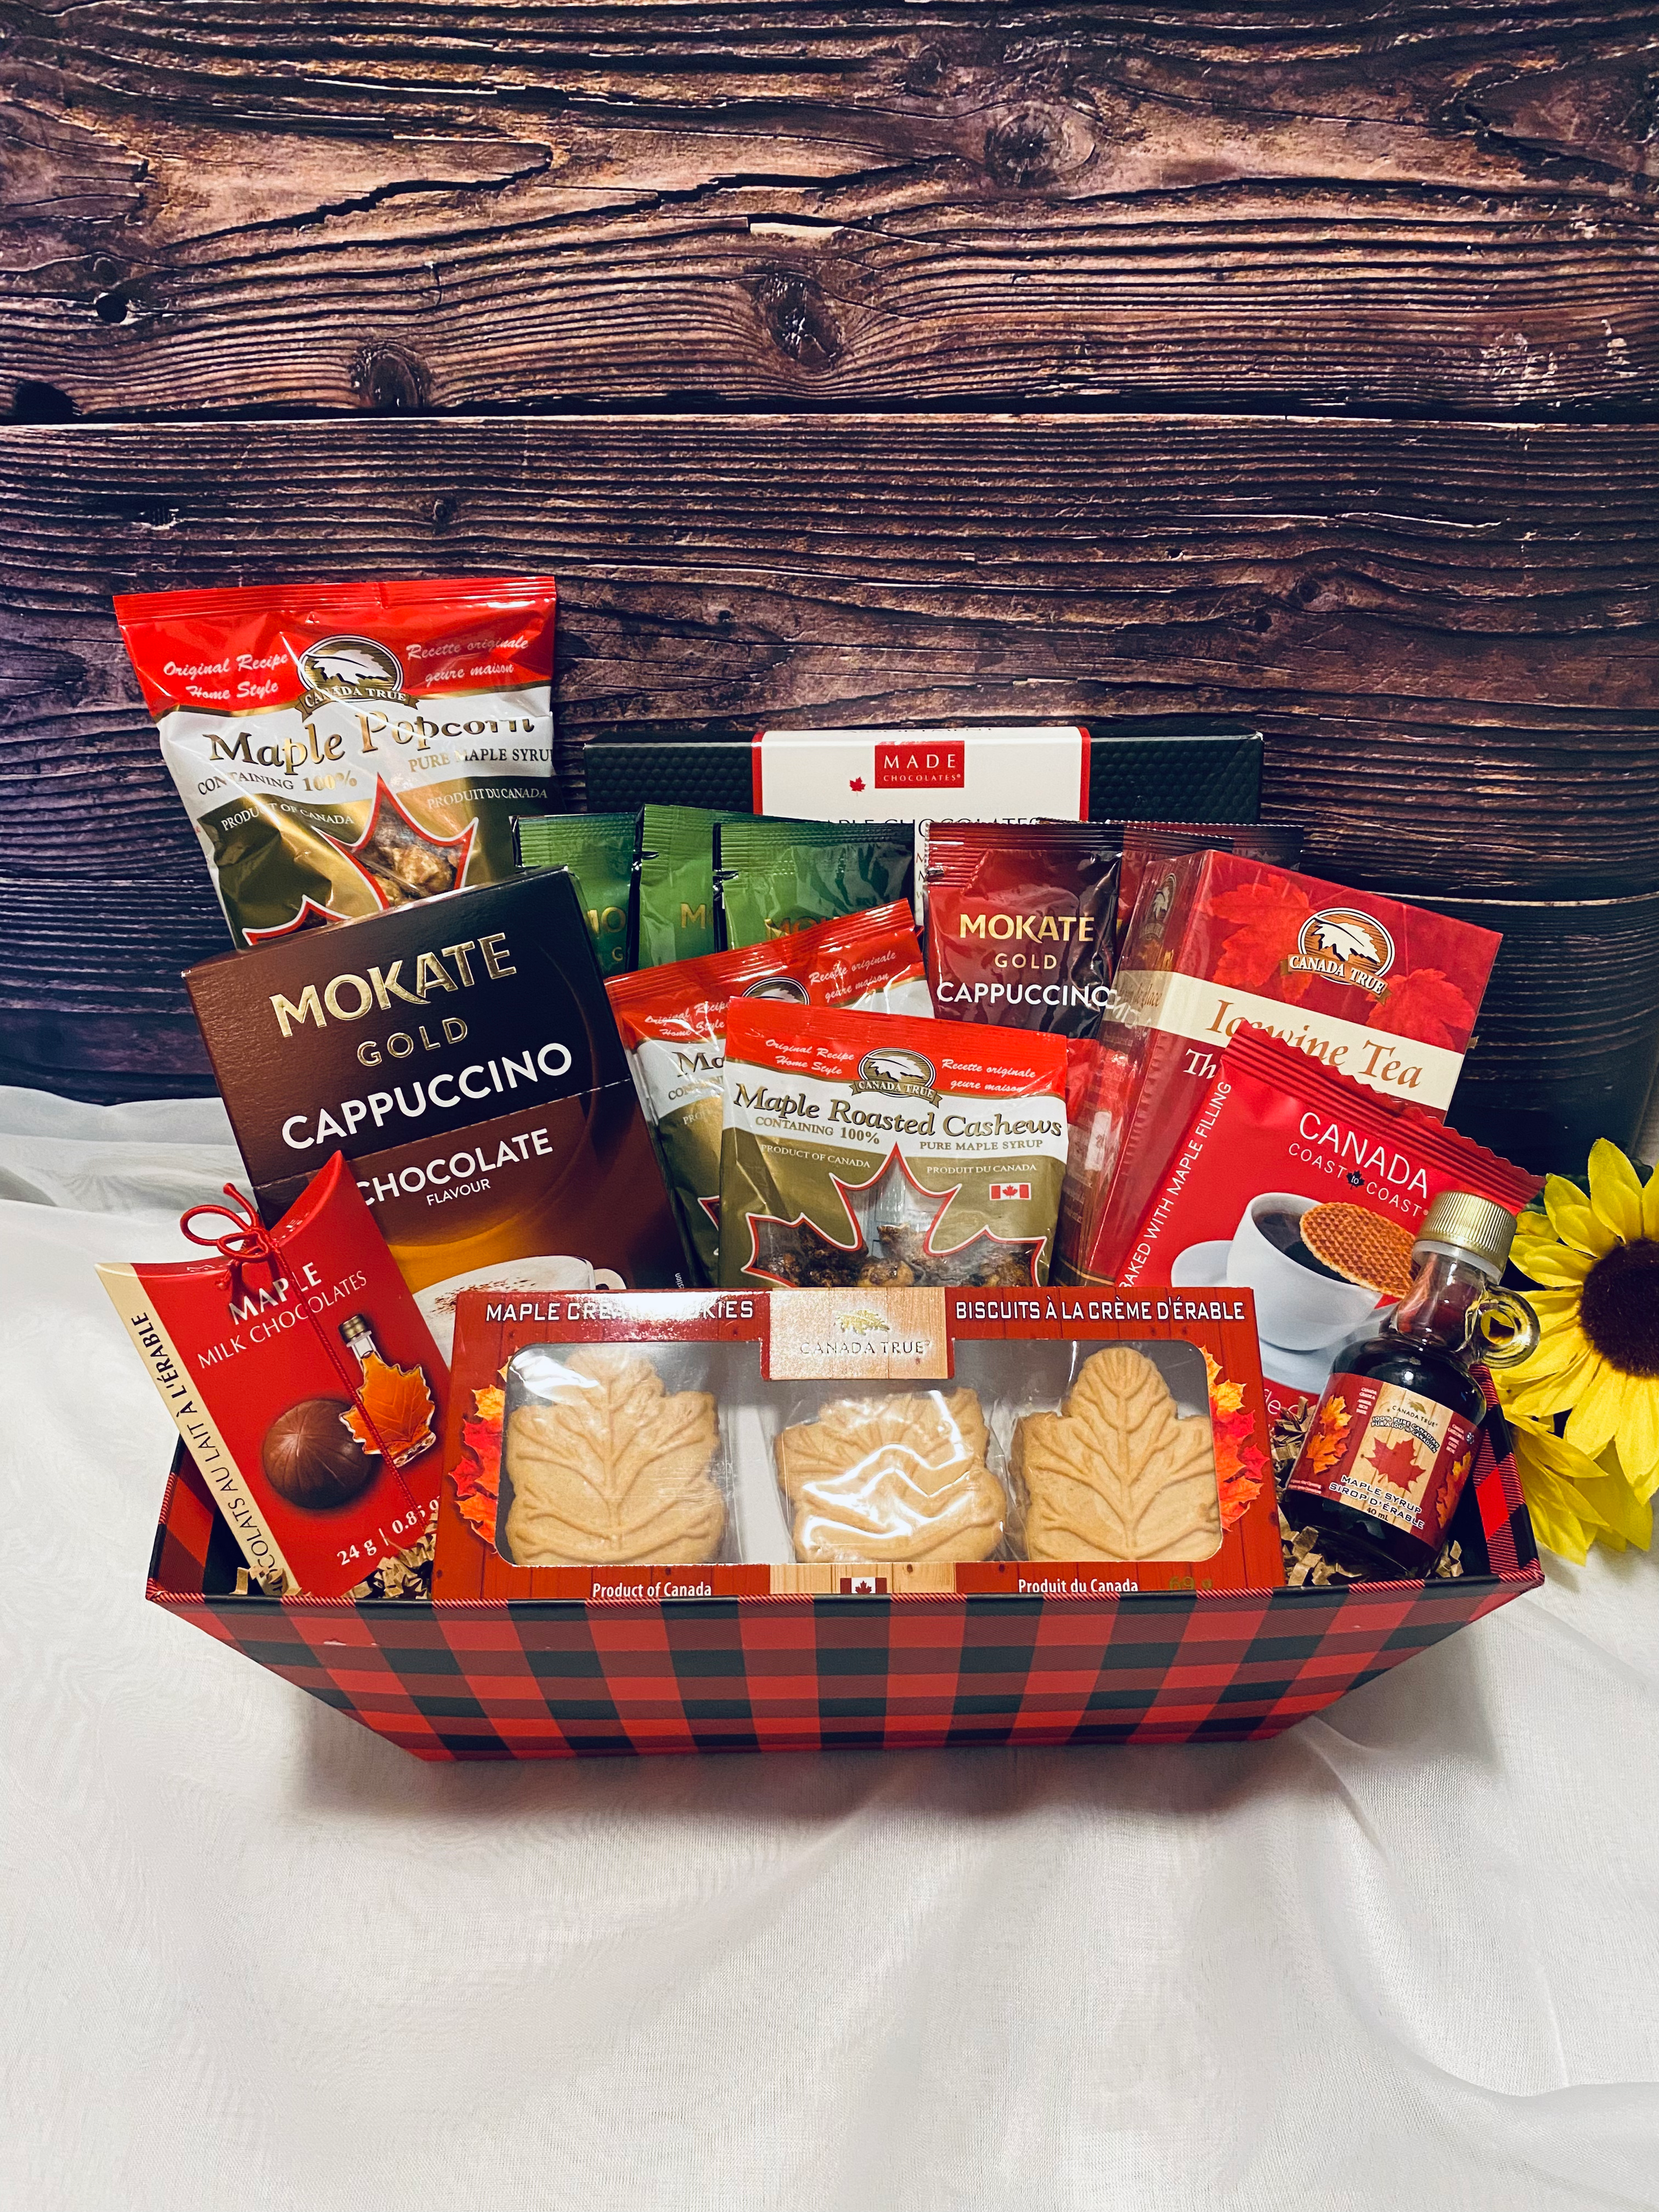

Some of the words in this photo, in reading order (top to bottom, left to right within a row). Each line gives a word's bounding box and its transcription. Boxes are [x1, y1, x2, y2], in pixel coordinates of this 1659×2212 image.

[405, 644, 461, 661] Recette
[467, 635, 529, 654] originale
[163, 658, 230, 680] Original
[236, 653, 288, 672] Recipe
[470, 663, 515, 675] maison
[185, 686, 230, 700] Home
[236, 679, 279, 698] Style
[304, 686, 363, 708] CANADA
[365, 688, 407, 701] TRUE
[202, 723, 346, 775] Maple
[354, 711, 535, 753] Popcorn
[408, 752, 450, 772] PURE
[454, 748, 507, 761] MAPLE
[512, 748, 553, 761] SYRU
[884, 754, 956, 769] MADE
[198, 772, 294, 795] CONTAINING
[304, 770, 357, 791] 100%
[427, 788, 485, 809] PRODUIT
[486, 788, 500, 798] DU
[501, 788, 548, 799] CANADA
[221, 803, 277, 831] PRODUT
[280, 803, 297, 812] OF
[300, 809, 355, 825] CANADA
[960, 913, 1094, 944] MOKATE
[851, 950, 896, 971] originale
[995, 953, 1057, 969] GOLD
[269, 932, 517, 1037] MOKATE
[855, 973, 889, 989] maison
[1289, 955, 1346, 978] CANADA
[1349, 967, 1385, 995] TRUE
[936, 981, 1110, 1007] CAPPUCCINO
[357, 1017, 468, 1066] GOLD
[659, 1028, 691, 1036] Home
[765, 1039, 812, 1054] Original
[816, 1047, 855, 1062] Recipe
[775, 1055, 808, 1068] Home
[811, 1062, 843, 1076] Style
[941, 1059, 983, 1073] Recette
[986, 1066, 1036, 1078] originale
[1183, 1048, 1218, 1080] Th
[1357, 1040, 1424, 1088] Tea
[281, 1042, 572, 1149] CAPPUCCINO
[858, 1080, 902, 1092] CANADA
[905, 1084, 935, 1098] TRUE
[985, 1082, 1025, 1093] maison
[733, 1082, 820, 1119] Maple
[827, 1098, 936, 1136] Roasted
[943, 1113, 1062, 1137] Cashews
[755, 1116, 834, 1136] CONTAINING
[840, 1127, 880, 1145] 100%
[761, 1144, 810, 1159] PRODUCT
[827, 1155, 871, 1168] CANADA
[919, 1142, 952, 1150] PURE
[955, 1142, 998, 1150] MAPLE
[1002, 1139, 1043, 1149] SYRUP
[1300, 1112, 1427, 1199] CANADA
[927, 1166, 974, 1174] PRODUIT
[992, 1164, 1037, 1172] CANADA
[1144, 1198, 1174, 1239] WITH
[1166, 1139, 1203, 1196] MAPLE
[1195, 1081, 1232, 1138] FILLING
[426, 1178, 491, 1206] FLAVOUR
[1289, 1143, 1347, 1178] COAST
[1351, 1175, 1359, 1184] to
[1367, 1182, 1422, 1216] COAST
[228, 1262, 322, 1325] MAPLE
[197, 1334, 246, 1369] MILK
[249, 1270, 367, 1343] CHOCOLATES
[486, 1302, 560, 1322] MAPLE
[567, 1301, 631, 1321] CRE
[955, 1301, 1041, 1319] BISCUITS
[1045, 1296, 1058, 1319] À
[1061, 1301, 1084, 1319] LA
[1088, 1296, 1152, 1319] CRÈME
[1157, 1296, 1245, 1319] D'ÉRABLE
[131, 1312, 187, 1398] L'ÉRABLE
[800, 1341, 875, 1355] CANADA
[176, 1401, 198, 1418] À
[1392, 1406, 1419, 1419] CANADA
[187, 1423, 220, 1462] LAIT
[1393, 1417, 1410, 1426] PURE
[1411, 1424, 1440, 1448] CANADIAN
[1412, 1430, 1437, 1453] CANADIEN
[211, 1466, 238, 1491] AU
[1329, 1482, 1368, 1500] SIROP
[1369, 1498, 1425, 1530] D'ÉRABLE
[1341, 1475, 1381, 1496] MAPLE
[1384, 1493, 1421, 1514] SYRUP
[336, 1544, 360, 1566] 24
[364, 1539, 377, 1556] g
[429, 1496, 440, 1510] o
[592, 1582, 644, 1598] Product
[647, 1582, 662, 1597] of
[664, 1581, 712, 1597] Canada
[1018, 1578, 1067, 1593] Produit
[1070, 1578, 1087, 1593] du
[1091, 1578, 1138, 1592] Canada
